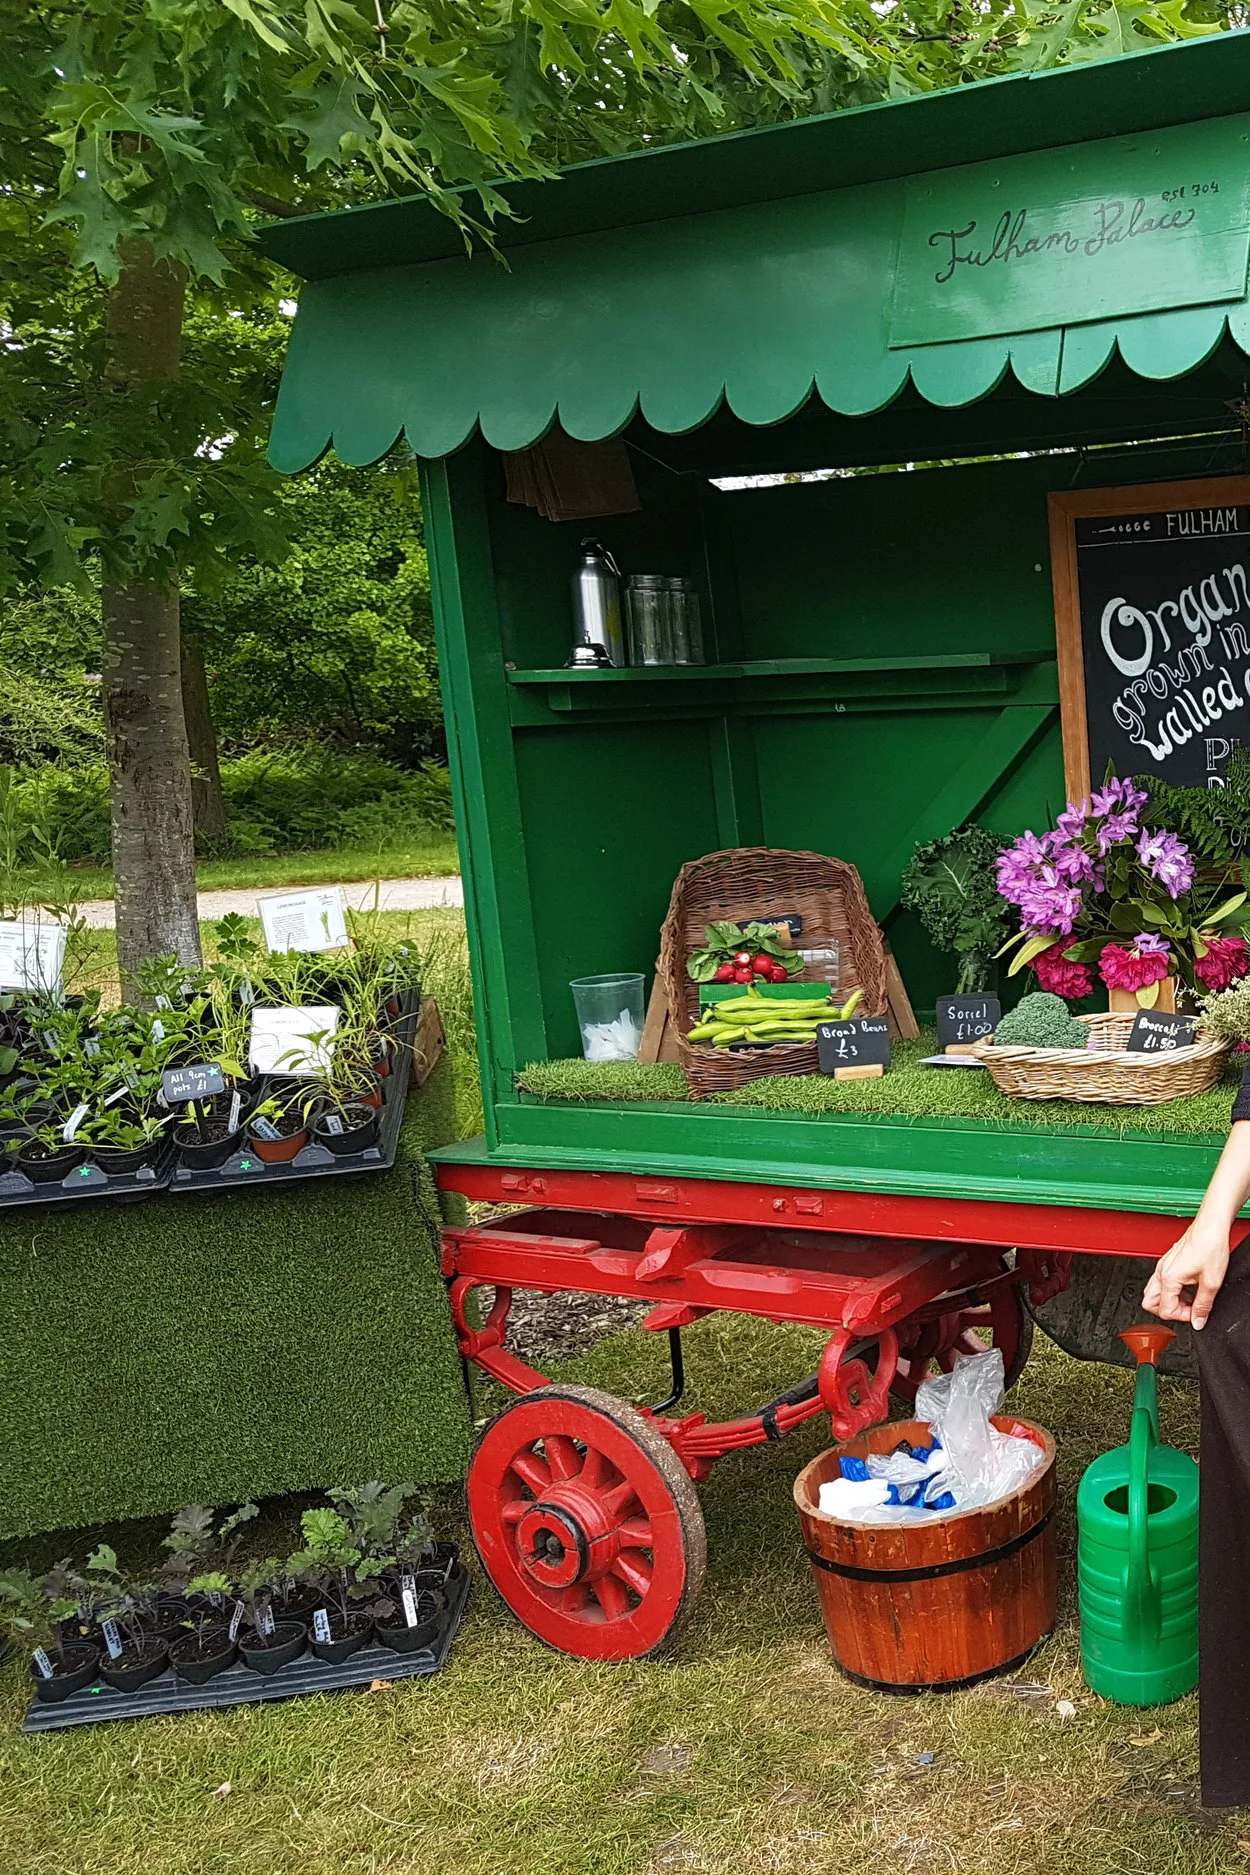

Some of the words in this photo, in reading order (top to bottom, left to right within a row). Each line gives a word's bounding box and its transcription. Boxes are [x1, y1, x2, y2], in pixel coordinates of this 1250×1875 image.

[1193, 180, 1219, 198] 704
[928, 209, 1079, 283] Fulham
[1084, 198, 1196, 256] Palace
[1166, 507, 1238, 535] FULHAM
[1112, 643, 1214, 744] grown
[1216, 624, 1250, 660] in
[1142, 667, 1243, 761] walled
[948, 1003, 986, 1019] Sorrel
[821, 1023, 856, 1038] Broad
[861, 1020, 888, 1032] Beans
[1138, 1017, 1179, 1035] Broccoli
[834, 1038, 858, 1059] £3
[1143, 1034, 1176, 1050] £1.50
[171, 1073, 183, 1083] All
[188, 1071, 205, 1079] 9cm
[173, 1083, 190, 1095] pots
[197, 1079, 206, 1090] £1
